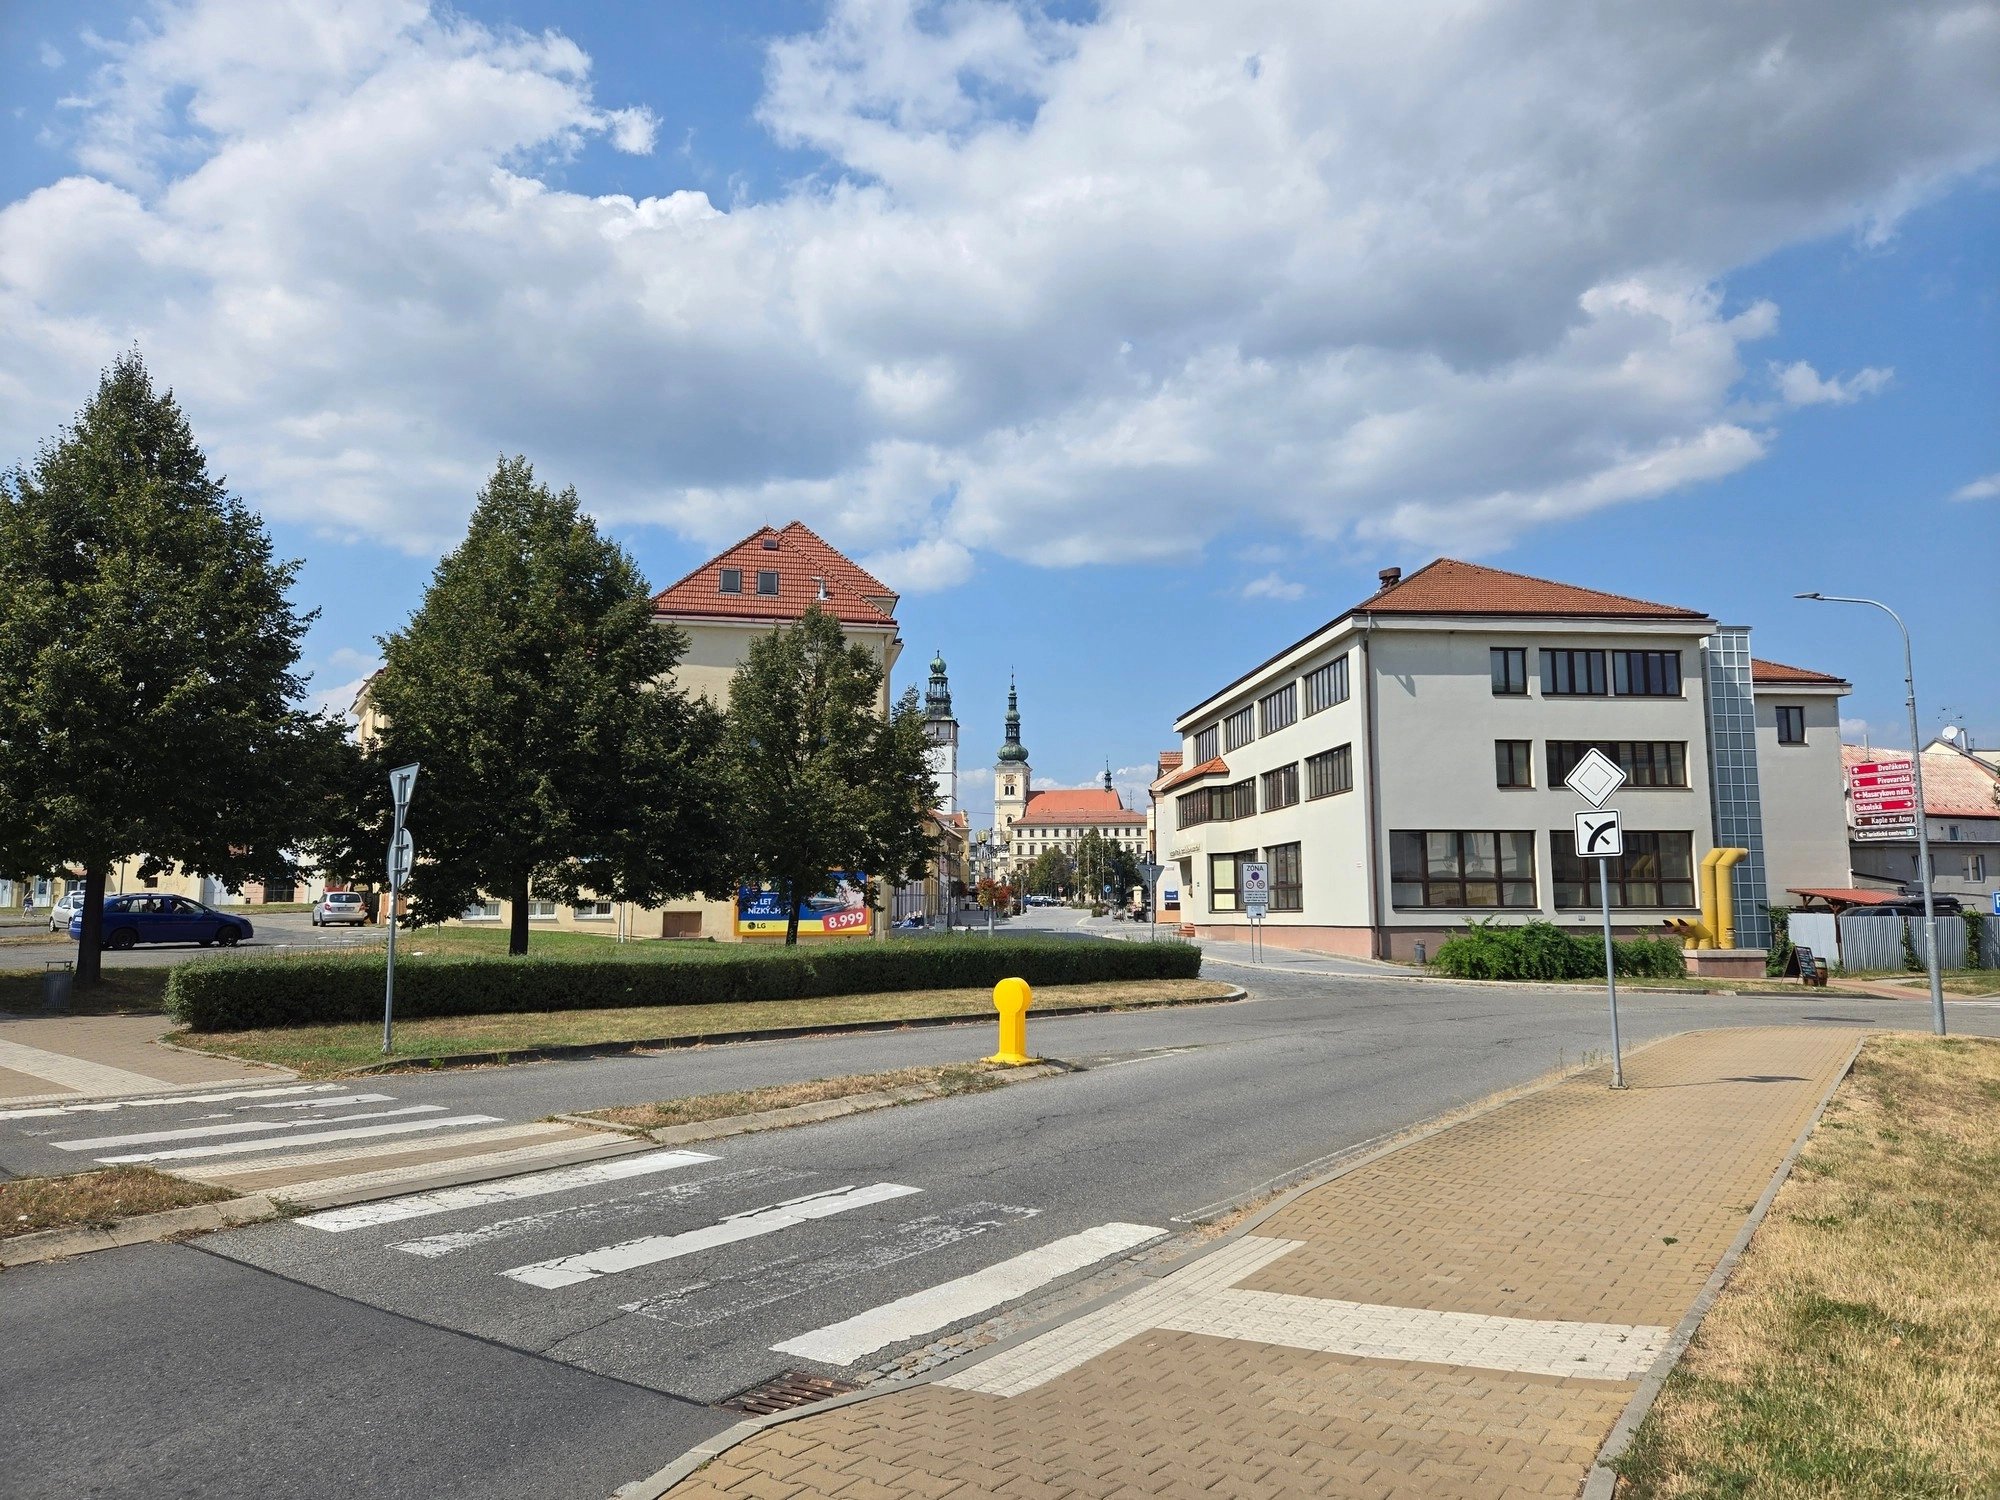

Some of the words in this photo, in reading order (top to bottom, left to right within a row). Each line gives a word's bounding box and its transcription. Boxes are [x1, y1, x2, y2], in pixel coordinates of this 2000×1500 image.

[1877, 775, 1910, 784] Pivovarská
[1862, 790, 1896, 798] Masarykovo
[1896, 788, 1911, 796] nám.
[1856, 803, 1883, 811] Sokolská
[1871, 817, 1888, 826] Kaple
[1898, 816, 1913, 824] Anny
[828, 912, 864, 928] 8.999
